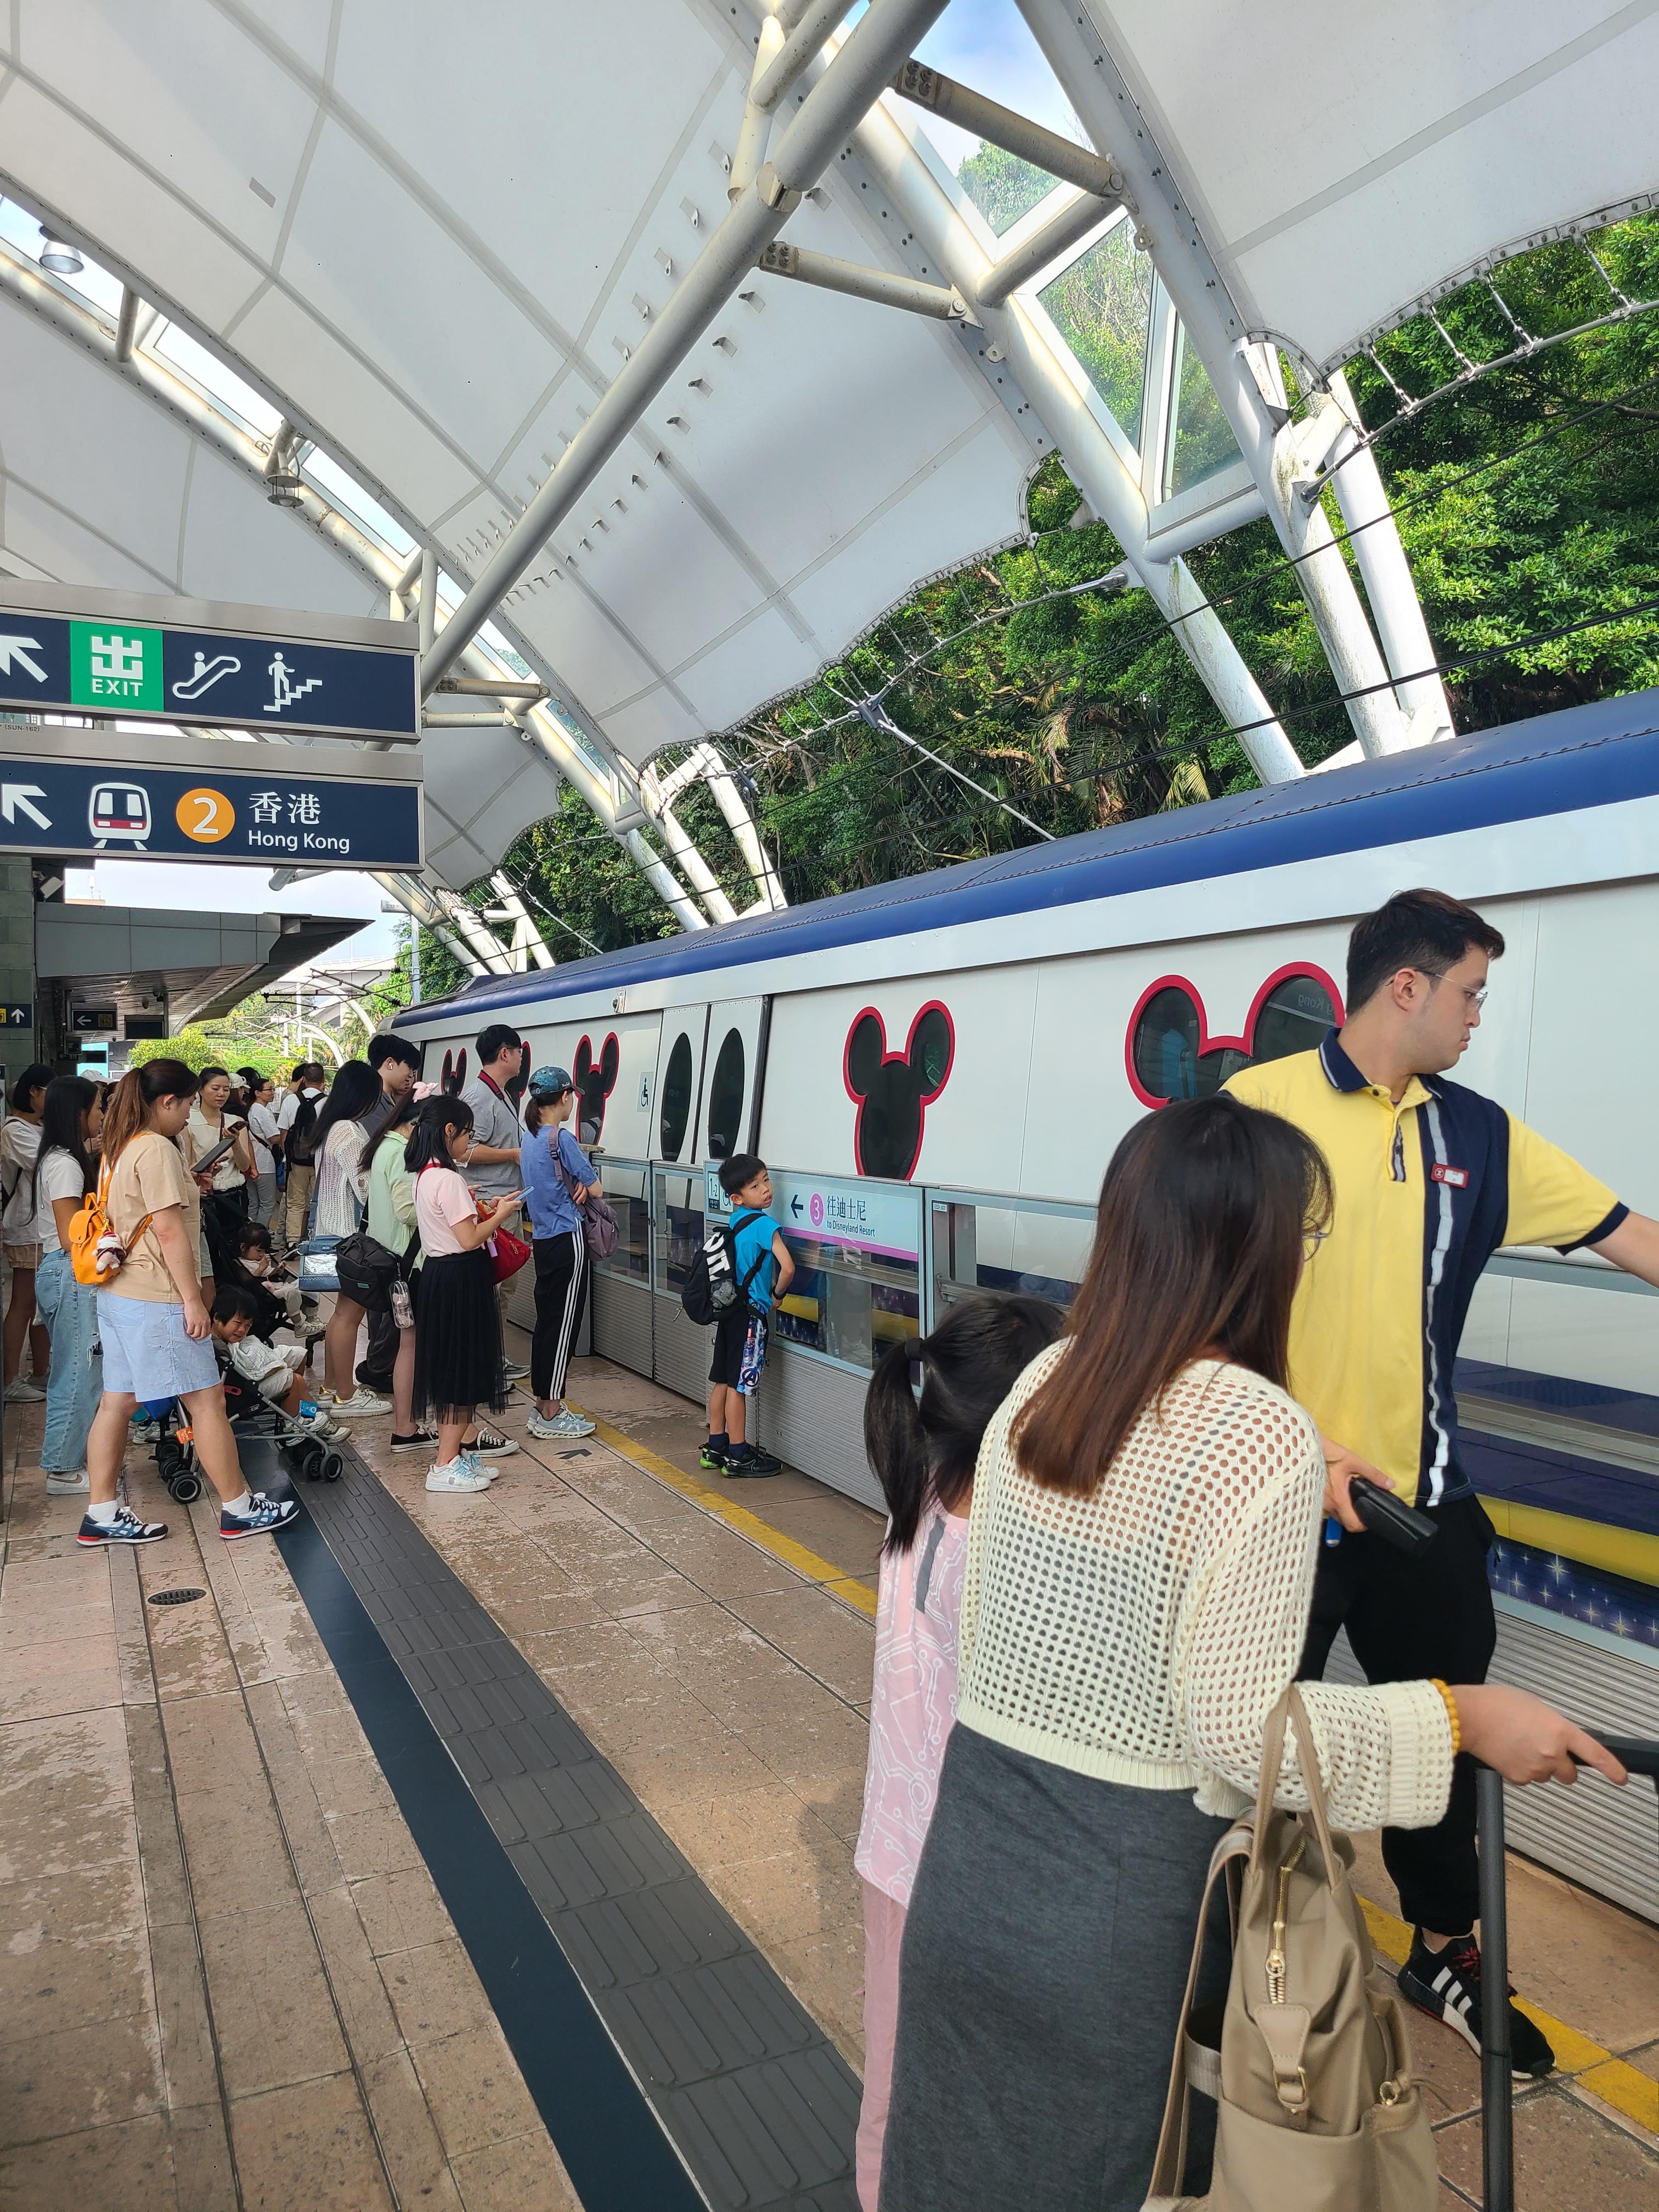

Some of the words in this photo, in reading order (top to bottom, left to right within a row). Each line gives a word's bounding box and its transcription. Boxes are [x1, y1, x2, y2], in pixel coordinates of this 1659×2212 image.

[92, 636, 143, 680] 出
[92, 678, 143, 697] EXIT
[5, 724, 40, 732] (SUN-162)
[193, 797, 218, 834] 2
[249, 792, 321, 825] 香港
[249, 830, 298, 852] Hong
[303, 833, 350, 854] Kong
[814, 1199, 820, 1220] 3
[826, 1195, 866, 1221] 往迪士尼
[827, 1220, 832, 1229] to
[832, 1220, 859, 1234] Disneyland
[859, 1224, 876, 1237] Resort
